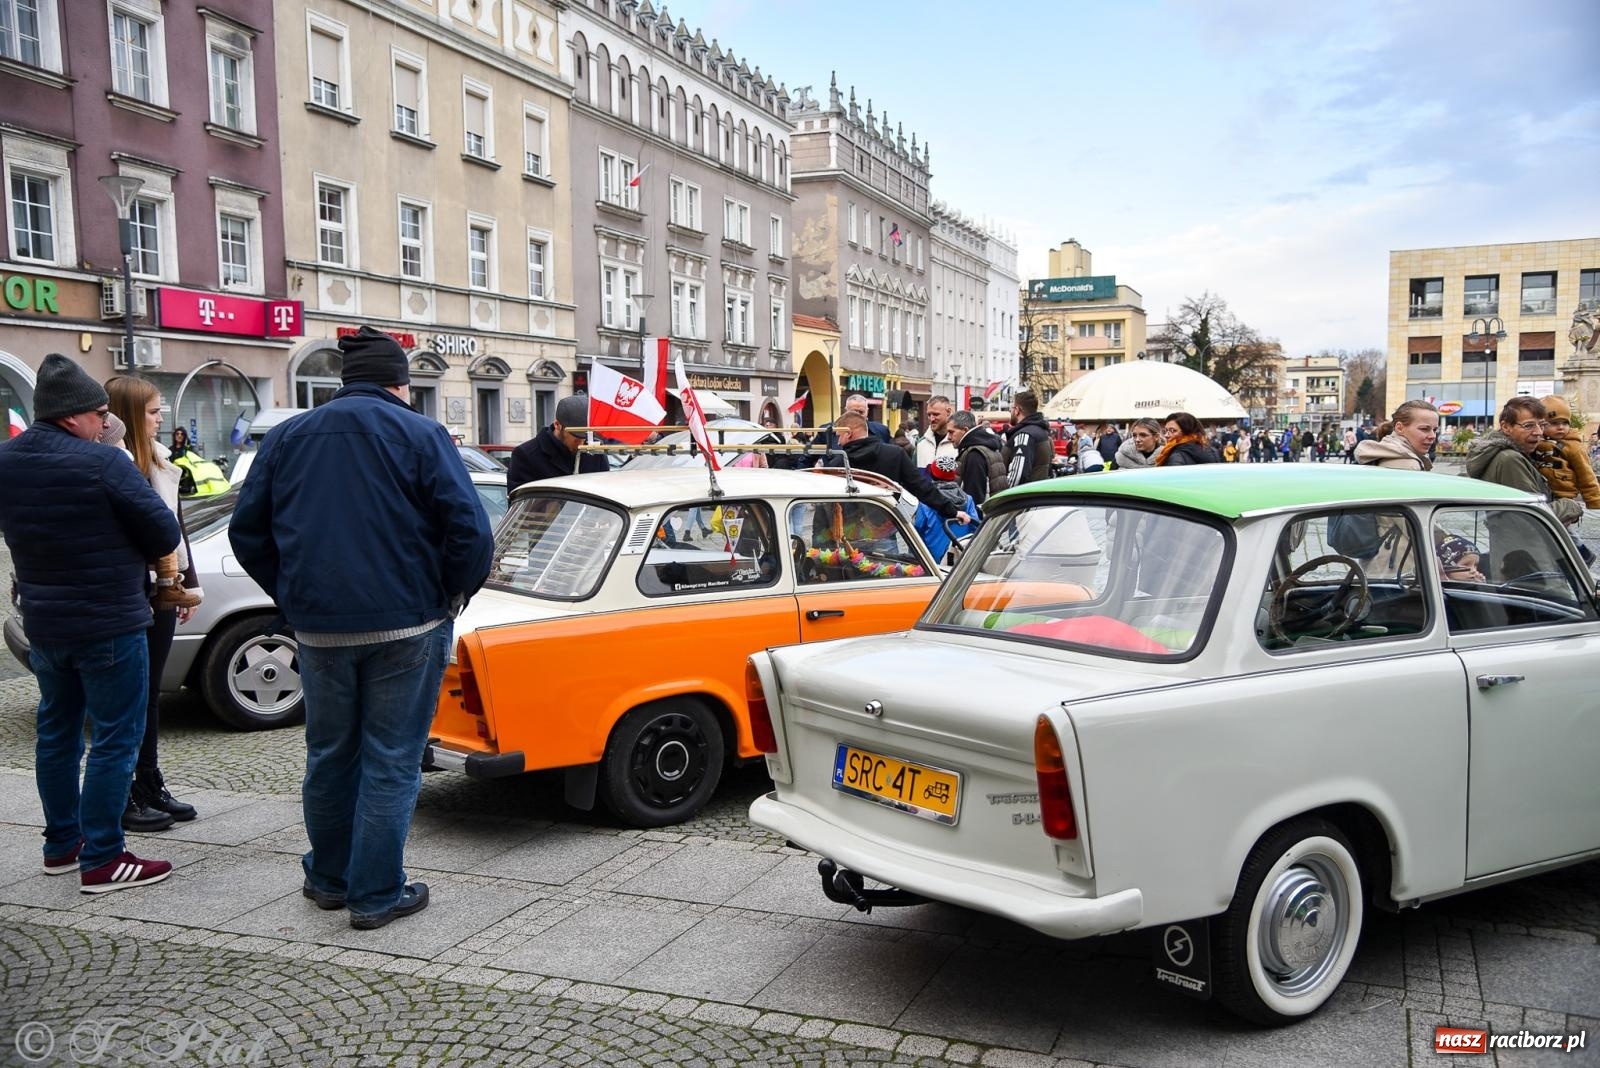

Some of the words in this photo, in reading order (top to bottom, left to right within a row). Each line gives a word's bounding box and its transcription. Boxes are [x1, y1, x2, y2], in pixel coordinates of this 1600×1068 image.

[0, 275, 59, 313] OR
[1050, 283, 1094, 293] McDonald's
[274, 306, 294, 331] T
[436, 334, 479, 356] SHIRO
[847, 752, 887, 792] SRC
[892, 765, 922, 801] 4T
